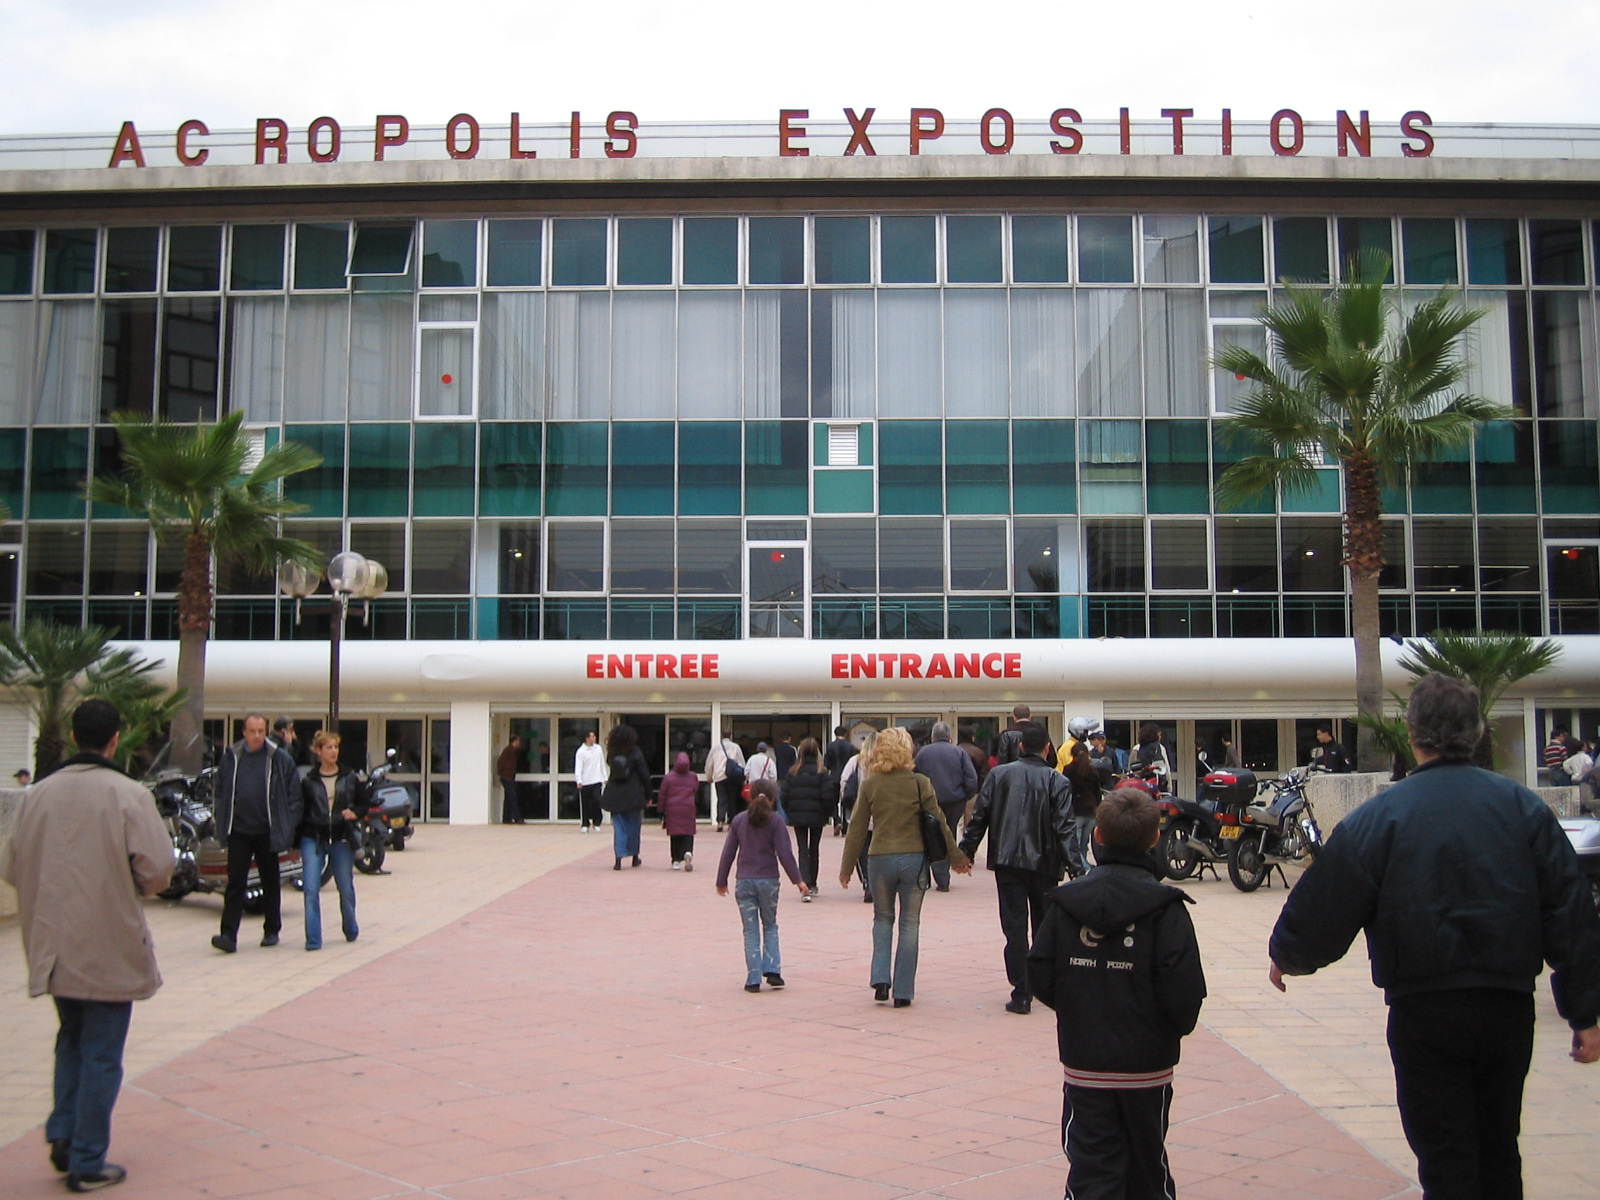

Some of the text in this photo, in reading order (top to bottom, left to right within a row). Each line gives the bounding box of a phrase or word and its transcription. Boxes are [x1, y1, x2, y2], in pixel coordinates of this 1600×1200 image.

[108, 106, 1436, 169] ACROPOLIS EXPOSITIONS
[586, 653, 720, 679] ENTREE
[831, 652, 1022, 679] ENTRANCE
[1069, 957, 1134, 970] NORTH POINT
